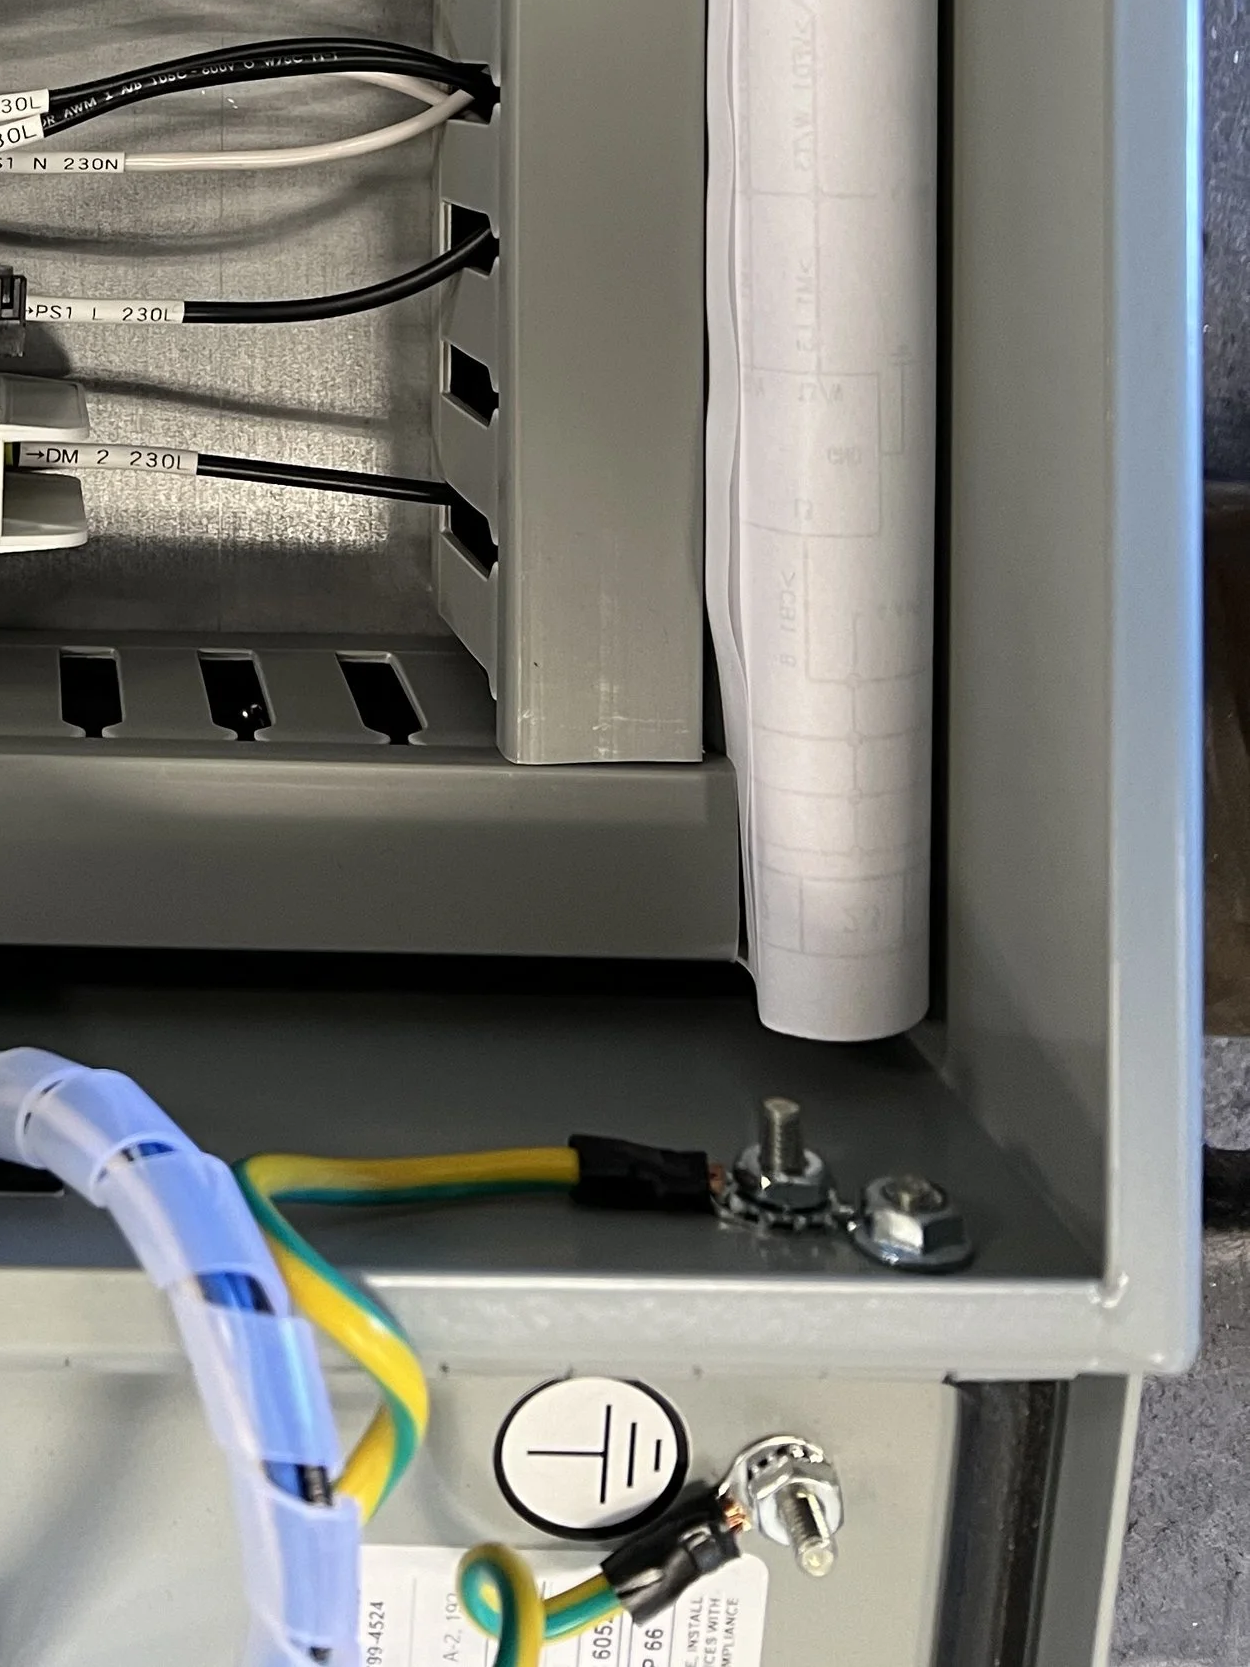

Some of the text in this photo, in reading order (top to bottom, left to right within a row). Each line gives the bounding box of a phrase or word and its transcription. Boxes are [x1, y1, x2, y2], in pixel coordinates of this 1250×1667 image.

[33, 157, 48, 170] N
[63, 157, 120, 171] 230N
[34, 304, 176, 323] PS1 L 230L
[45, 448, 187, 471] DM 2 230L
[707, 1596, 721, 1630] WITH
